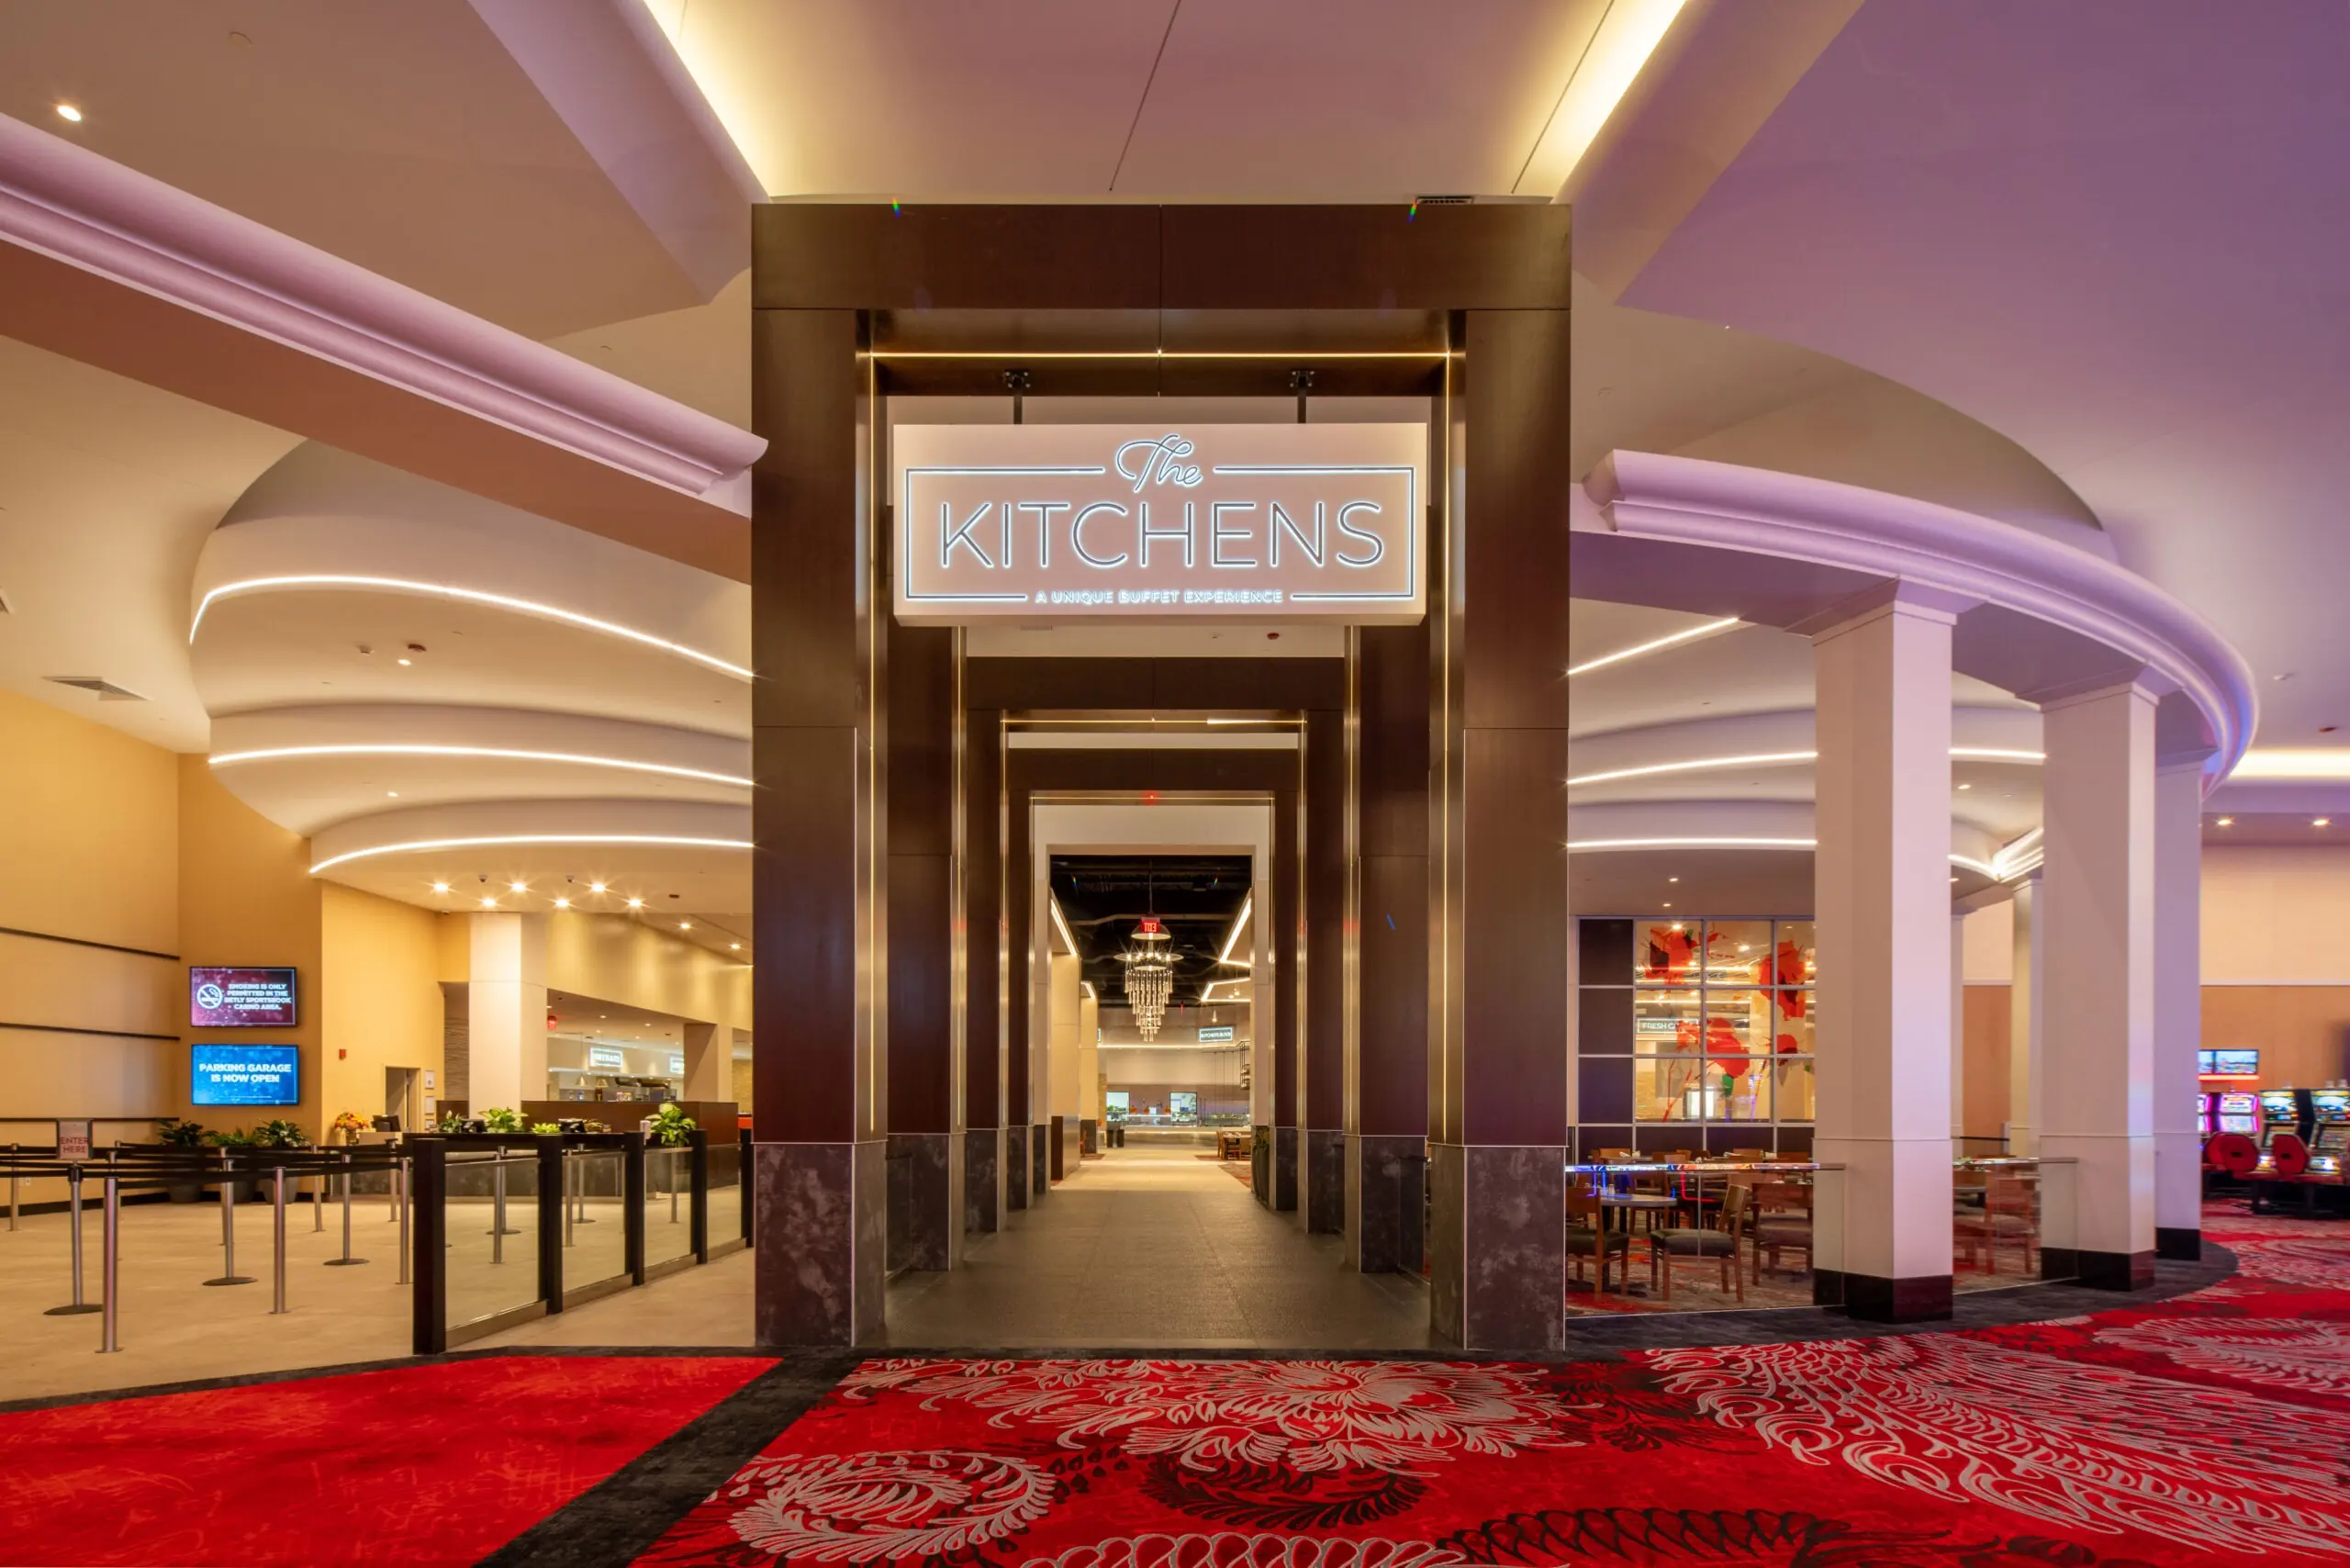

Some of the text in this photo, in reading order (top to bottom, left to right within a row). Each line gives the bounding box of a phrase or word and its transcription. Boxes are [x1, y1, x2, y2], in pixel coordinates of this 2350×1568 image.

[1116, 433, 1203, 493] The
[940, 501, 1384, 568] KITCHENS
[1035, 590, 1283, 605] A UNIQUE BUFFET EXPERIENCE
[199, 1063, 292, 1072] PARKING GARAGE
[211, 1073, 280, 1083] IS NOW OPEN
[62, 1145, 87, 1153] HERE
